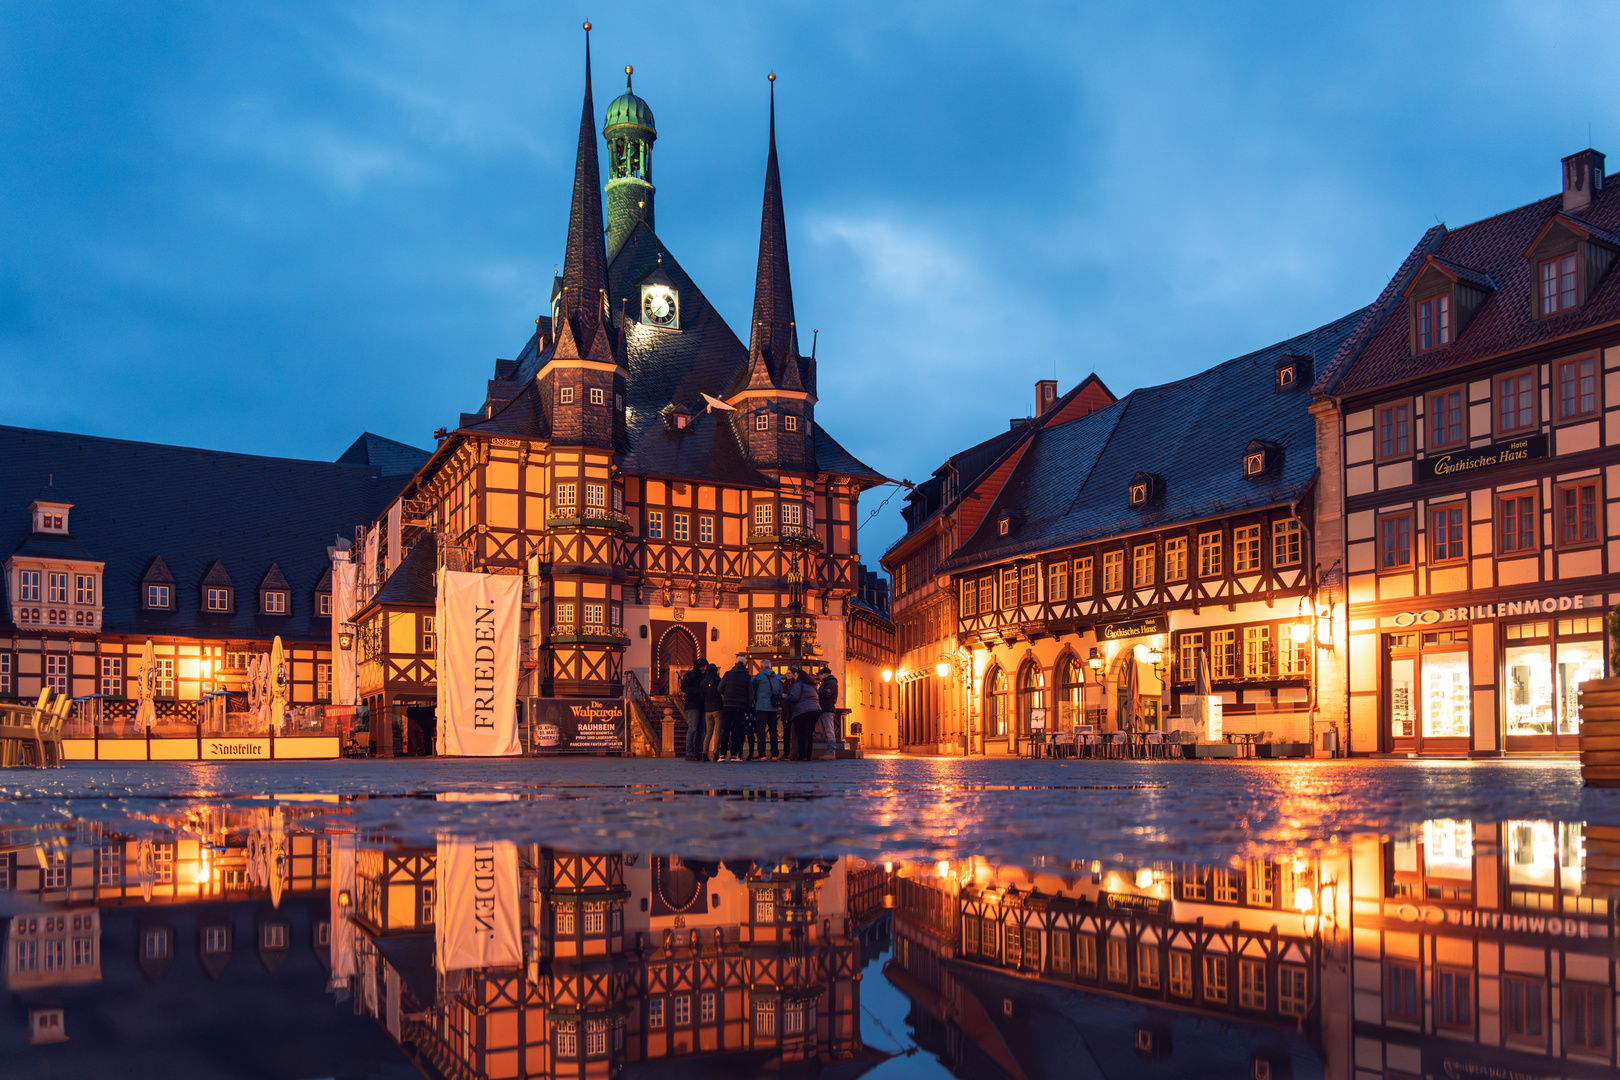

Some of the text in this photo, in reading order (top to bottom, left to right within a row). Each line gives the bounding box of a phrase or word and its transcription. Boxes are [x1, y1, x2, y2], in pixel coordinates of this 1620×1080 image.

[1511, 440, 1528, 450] Hotel
[1434, 449, 1528, 475] Gothisches Haus
[1446, 595, 1584, 622] BRILLENMODE
[1104, 624, 1157, 639] Gothisches Haus
[474, 599, 495, 730] FRIEDEN.
[591, 701, 603, 709] Die
[569, 705, 623, 723] Walpurgis
[577, 723, 615, 731] RAUHBEIN
[211, 743, 262, 755] Ratskeller
